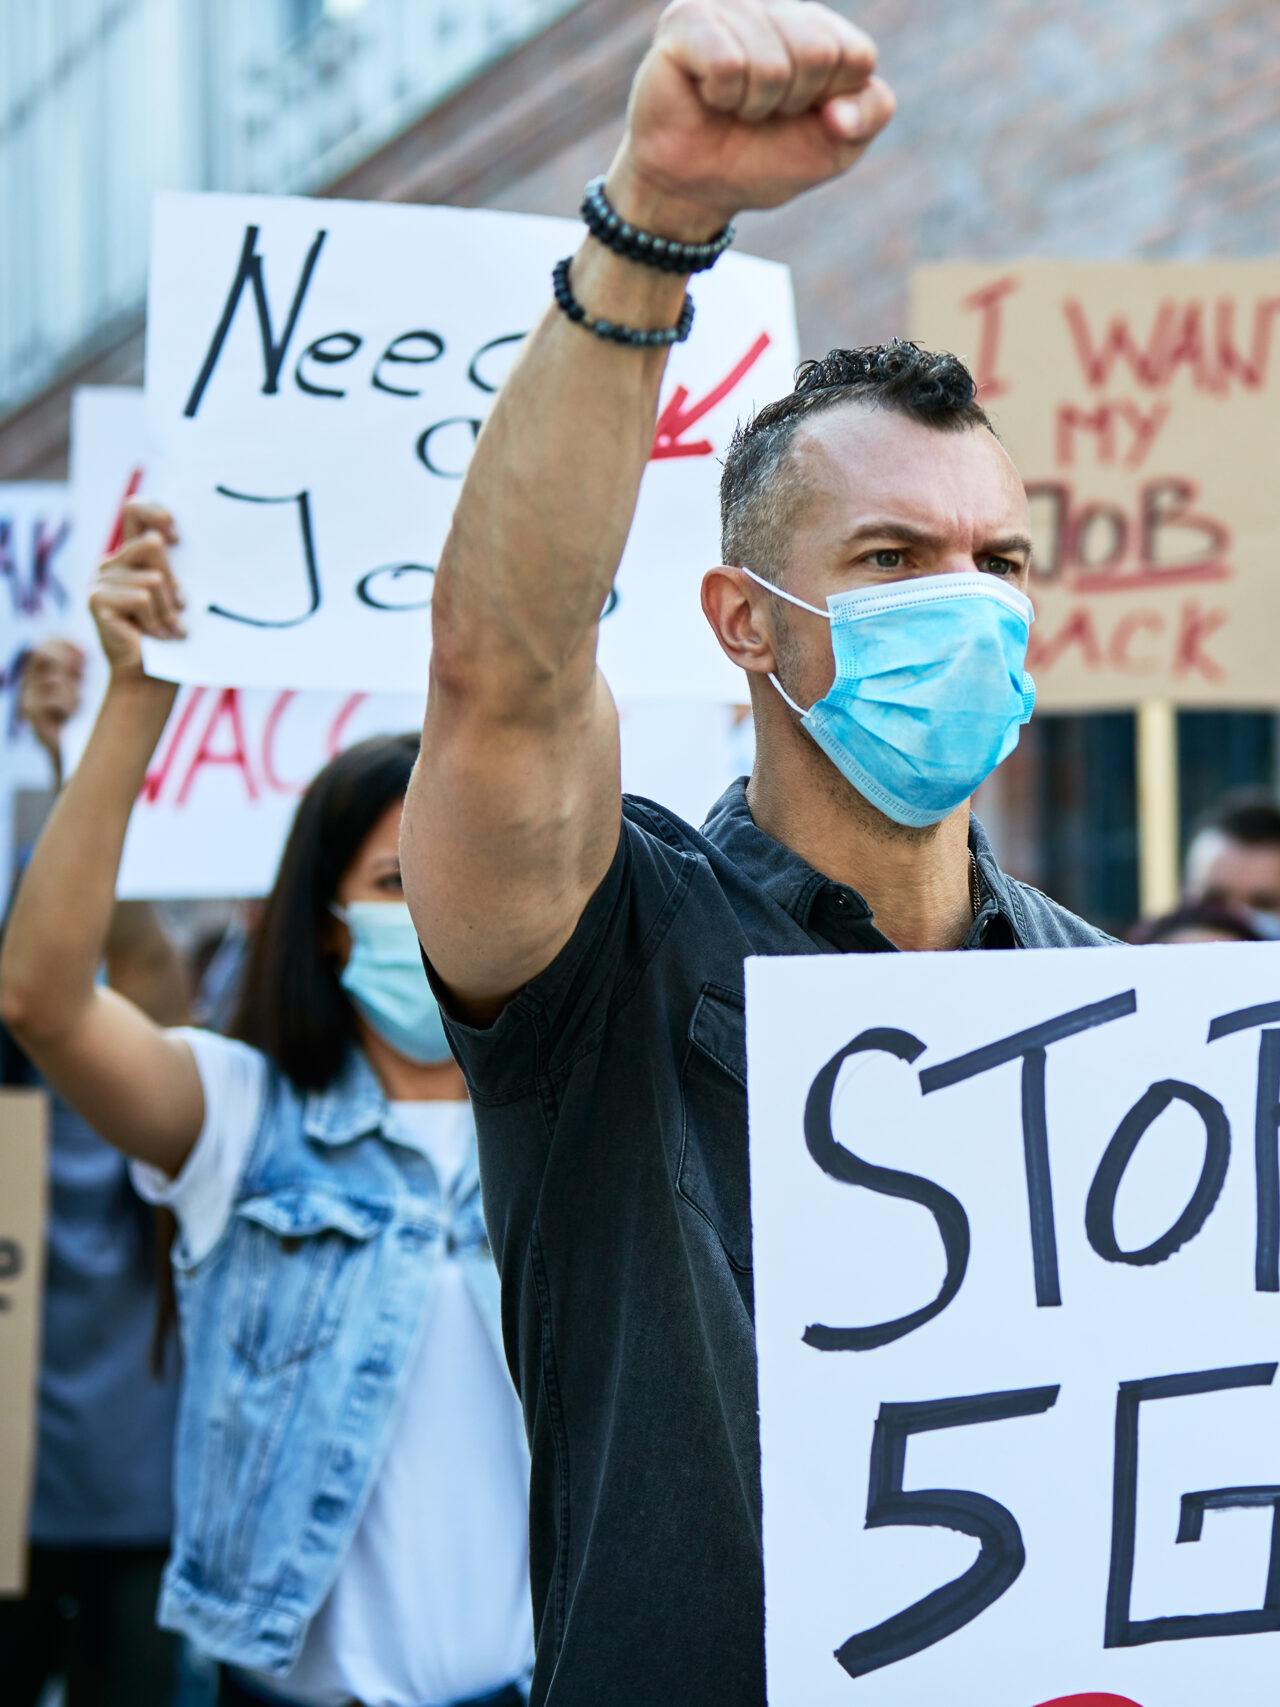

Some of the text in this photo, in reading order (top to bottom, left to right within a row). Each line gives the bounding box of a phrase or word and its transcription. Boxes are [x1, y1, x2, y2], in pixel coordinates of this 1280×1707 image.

[962, 276, 1020, 401] I
[1055, 402, 1171, 469] MY
[207, 485, 620, 629] Jo
[1026, 597, 1230, 683] ACK
